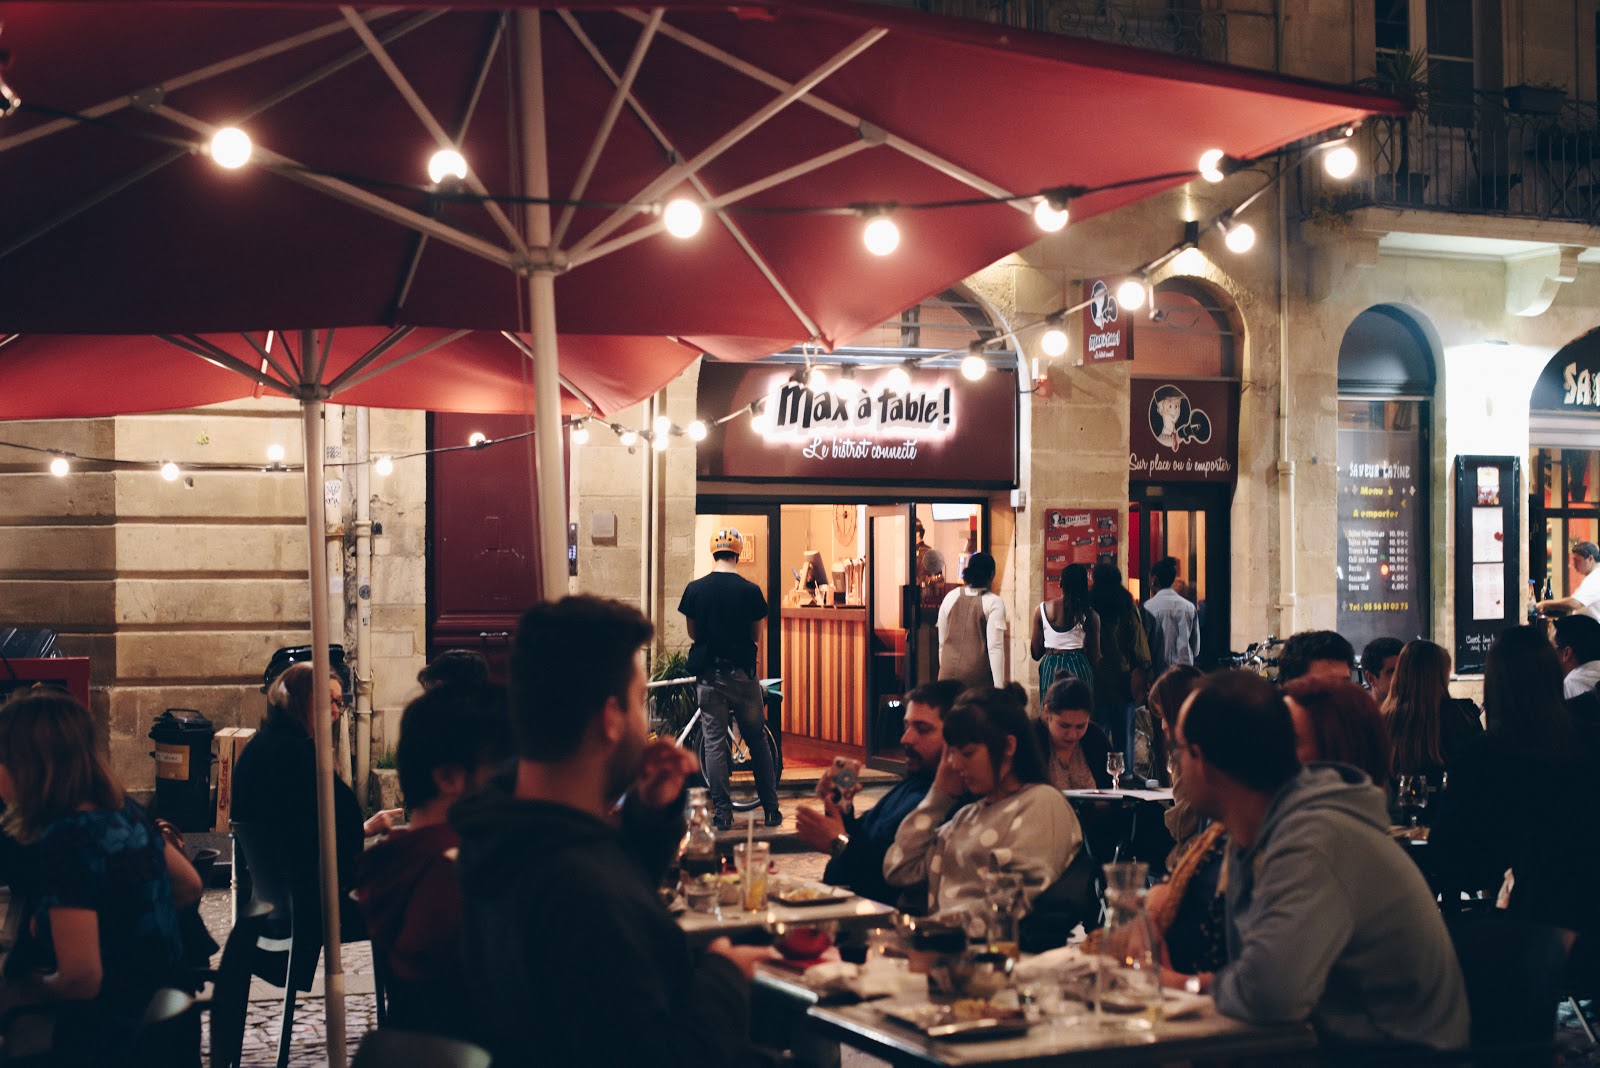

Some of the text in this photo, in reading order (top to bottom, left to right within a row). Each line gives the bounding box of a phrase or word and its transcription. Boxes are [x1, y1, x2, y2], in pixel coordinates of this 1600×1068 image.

[1563, 362, 1600, 406] SA
[777, 384, 848, 428] Max
[858, 389, 872, 419] à
[803, 436, 918, 460] Le bistrot connecté
[1129, 453, 1232, 478] Sur place ou à emporter
[1349, 461, 1380, 478] SAVEUR
[1360, 486, 1384, 496] Menu
[1360, 509, 1399, 519] emporter
